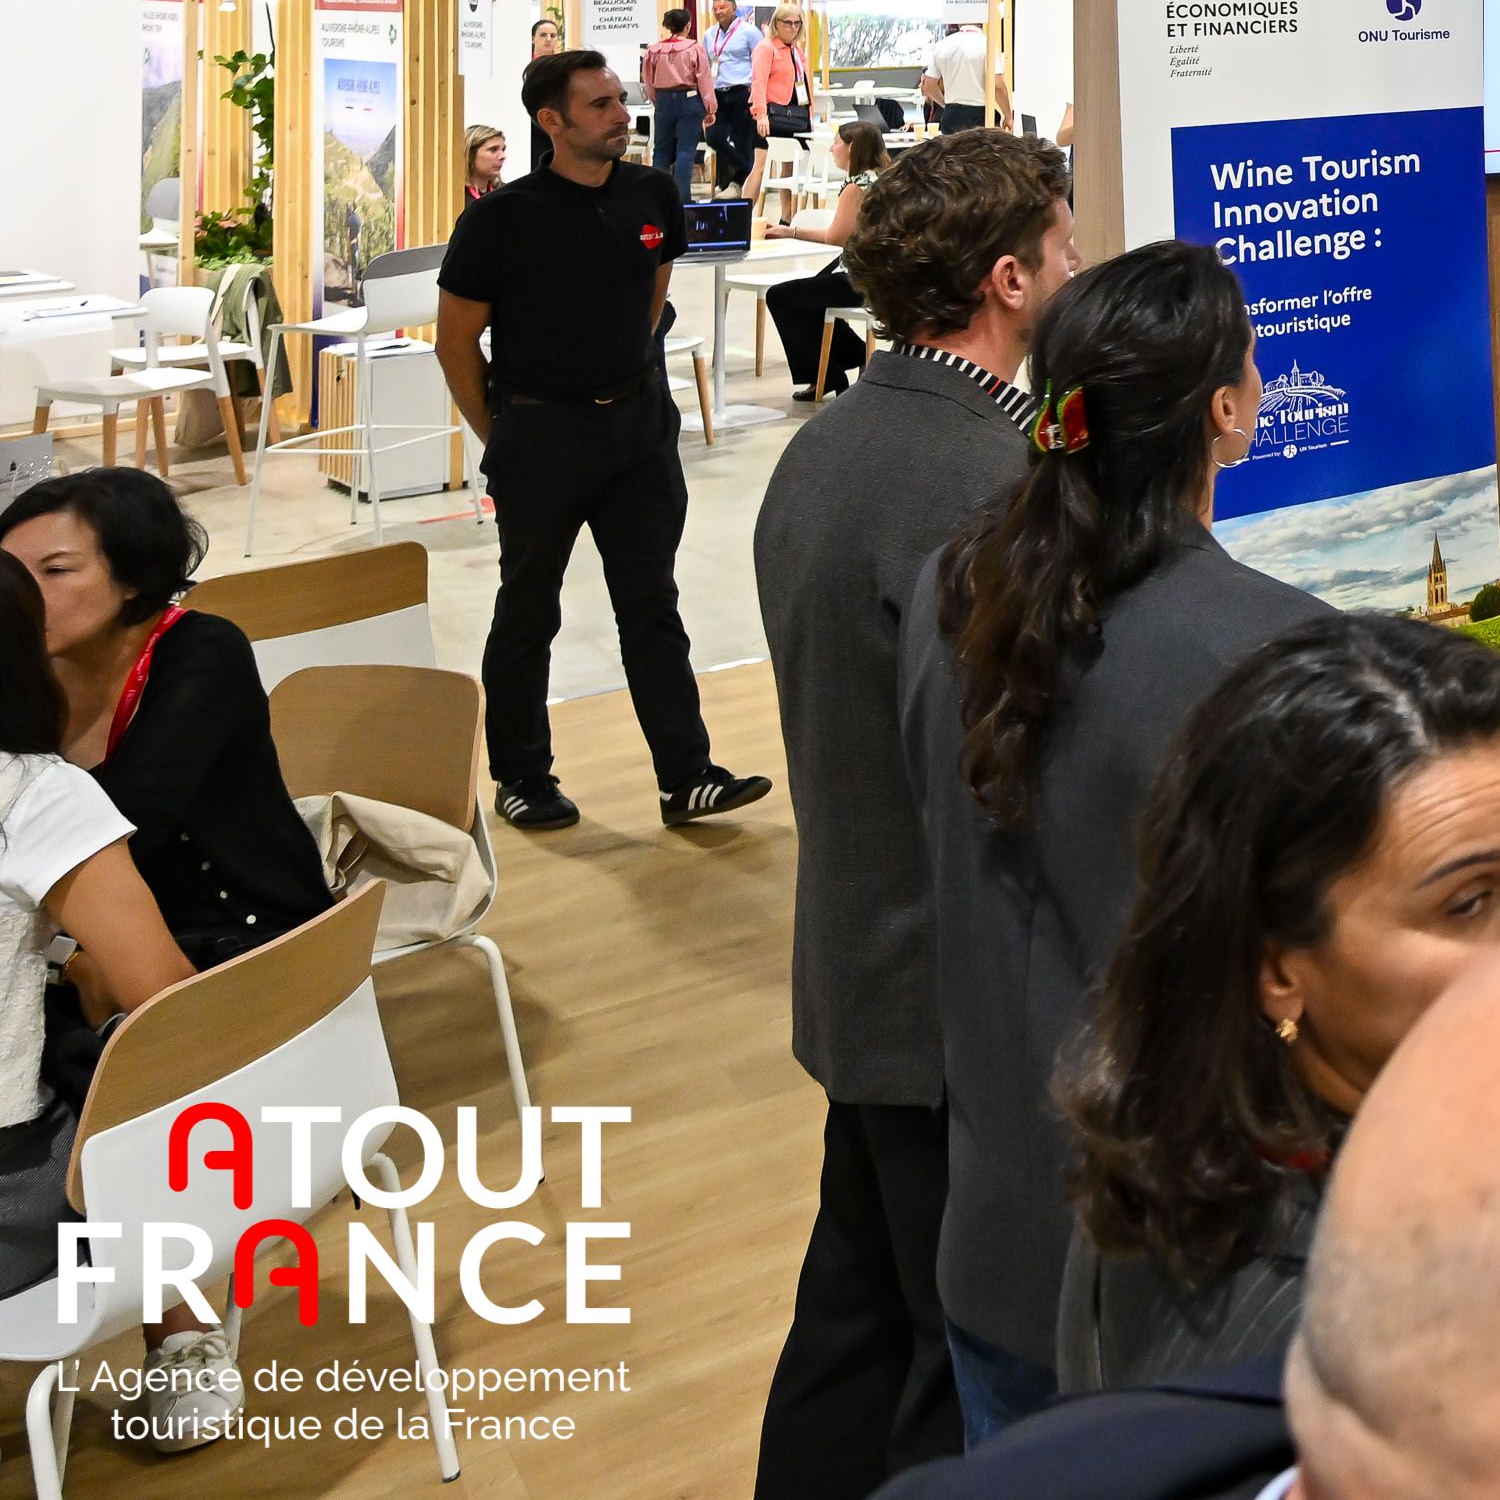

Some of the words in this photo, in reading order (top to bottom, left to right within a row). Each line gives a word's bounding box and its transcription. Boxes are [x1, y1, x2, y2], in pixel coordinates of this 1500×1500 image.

[599, 15, 633, 23] CHÂTEAU
[1166, 0, 1298, 20] ÉCONOMIQUES
[1166, 22, 1188, 38] ET
[1193, 19, 1298, 37] FINANCIERS
[1358, 29, 1389, 43] ONU
[1391, 28, 1451, 42] Tourisme
[1169, 44, 1199, 54] Liberté
[1169, 55, 1200, 67] Égalité
[1169, 67, 1212, 78] Fraternité
[1210, 161, 1293, 191] Wine
[1301, 149, 1421, 183] Tourism
[1212, 190, 1379, 229] Innovation
[1215, 230, 1366, 266] Challenge
[1244, 295, 1319, 316] nsformer
[1254, 313, 1351, 338] touristique
[1275, 402, 1349, 425] Tourism
[1253, 415, 1350, 448] HALLENGE
[1252, 452, 1274, 461] Powered
[1308, 443, 1328, 451] Tourism
